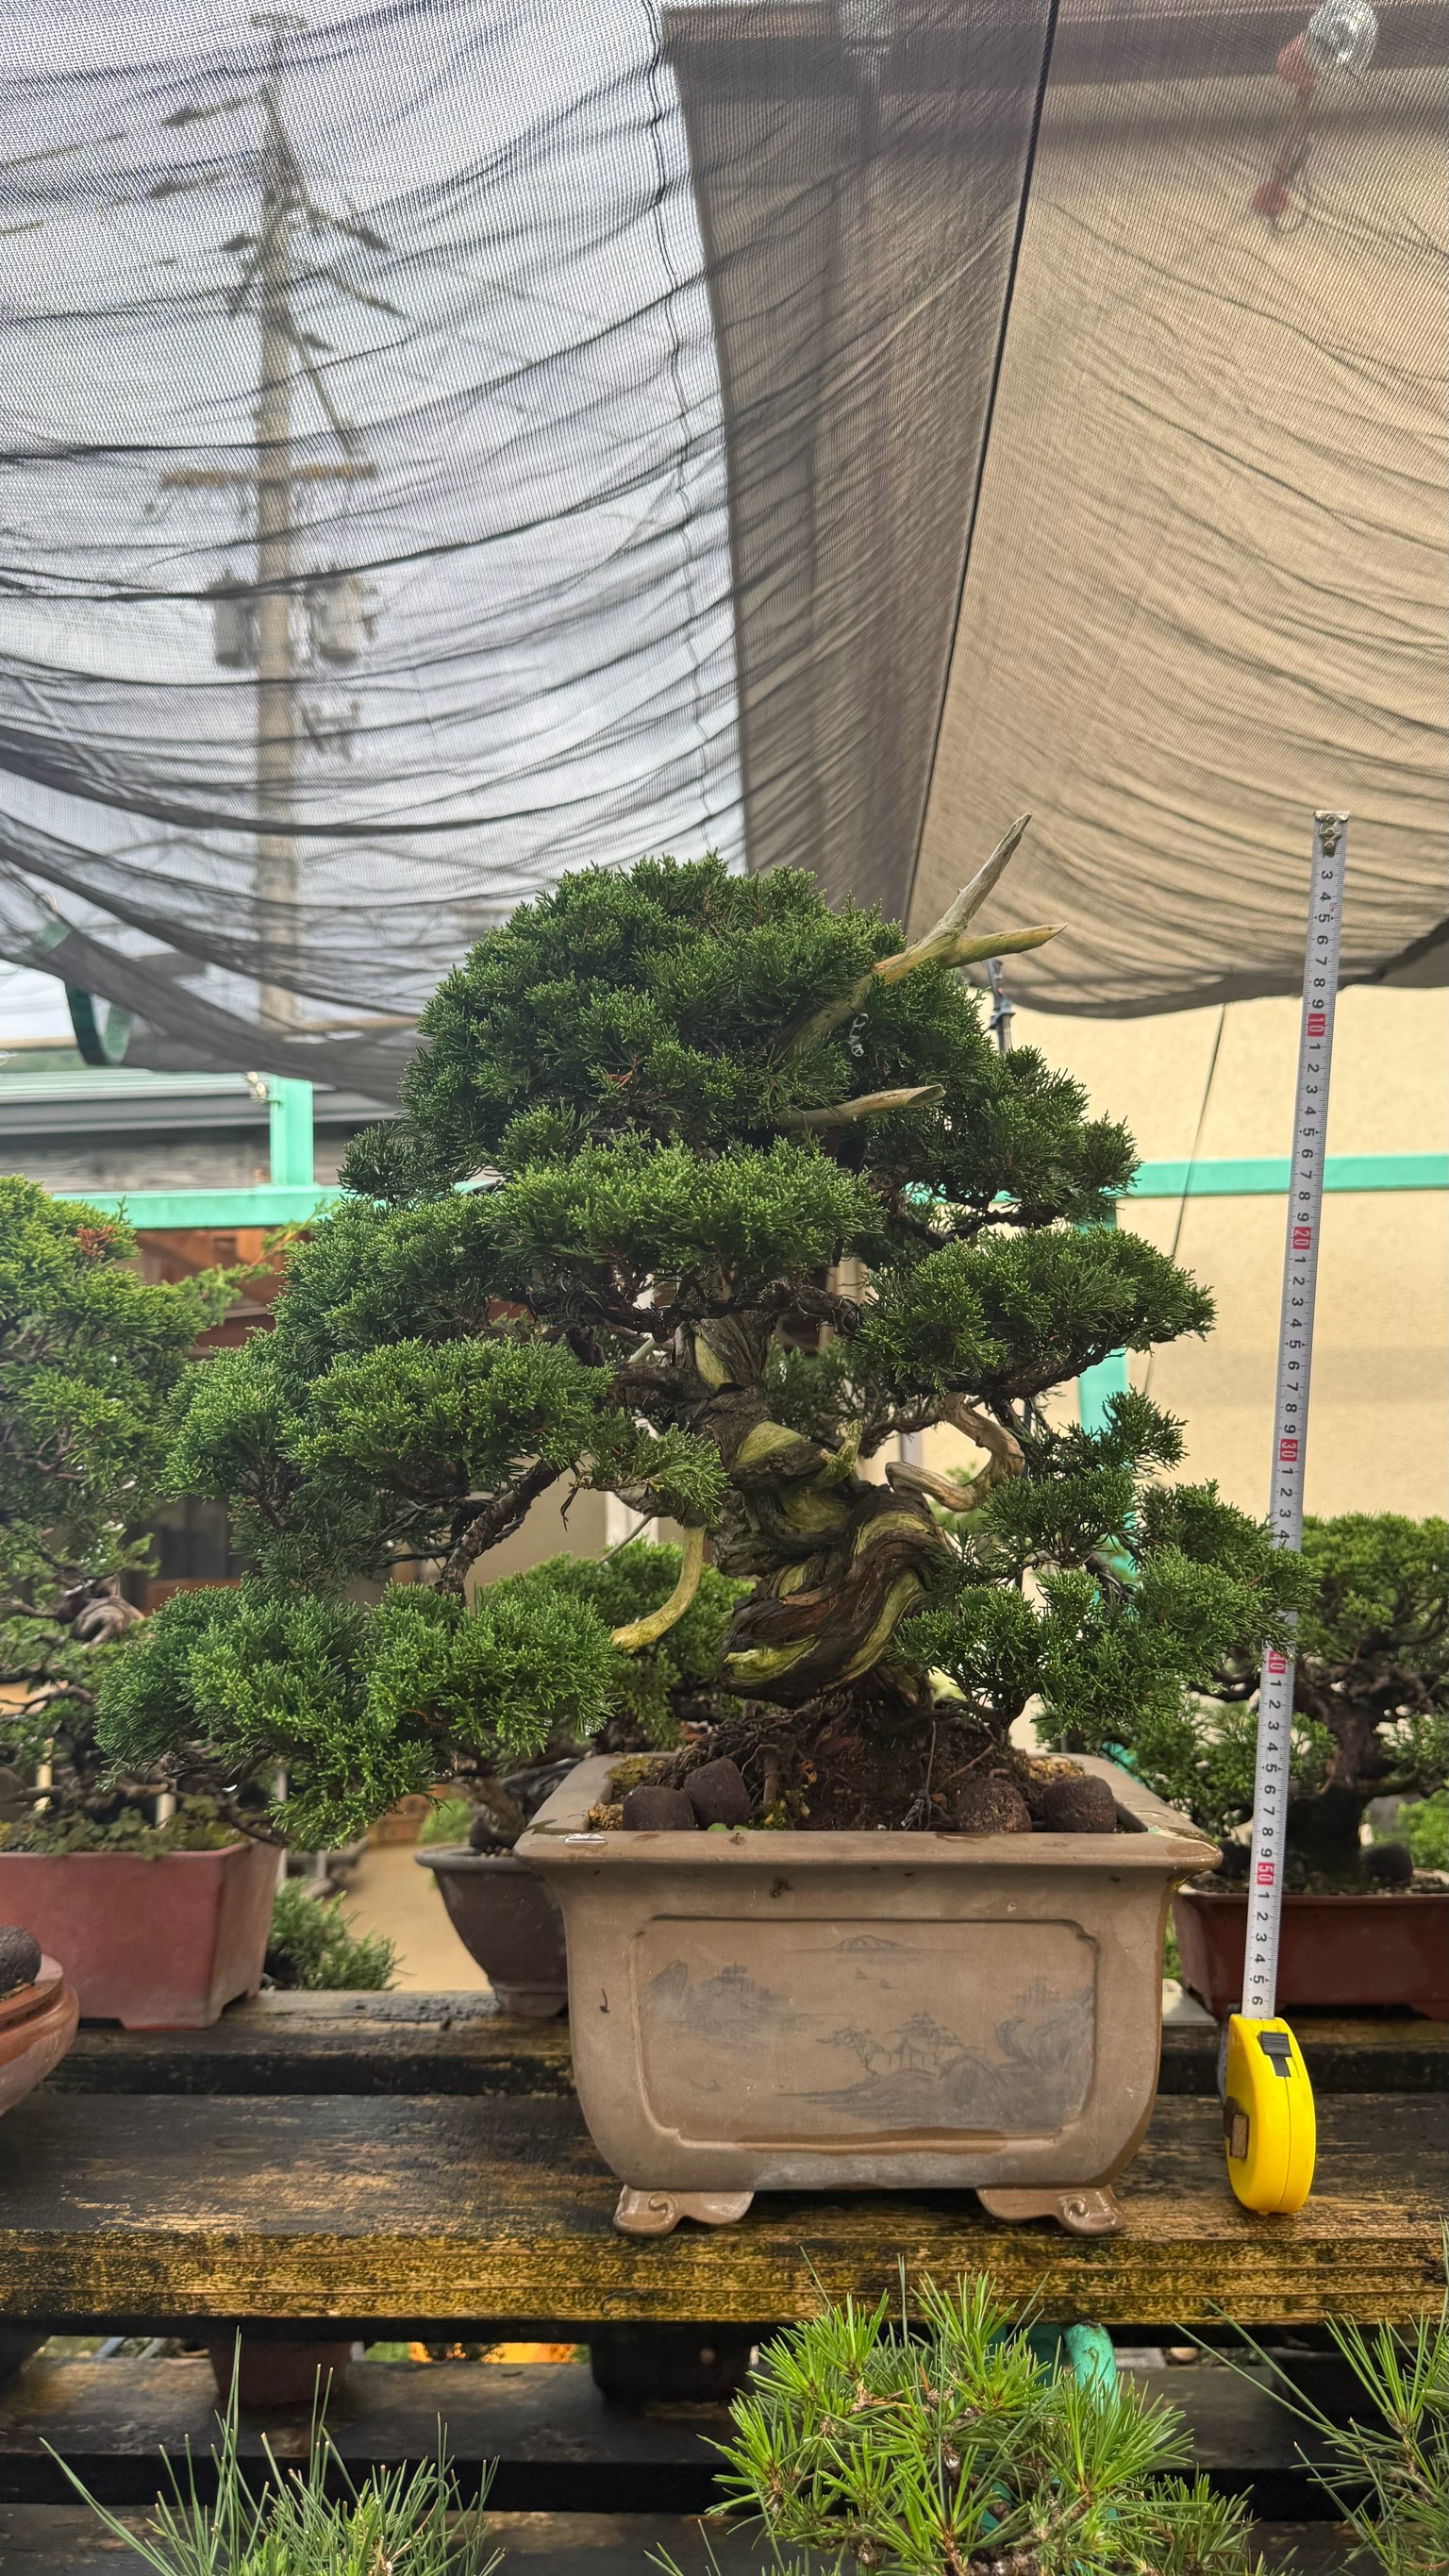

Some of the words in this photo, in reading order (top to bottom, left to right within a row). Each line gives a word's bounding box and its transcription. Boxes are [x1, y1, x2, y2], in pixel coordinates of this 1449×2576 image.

[1321, 870, 1333, 880] 3
[1319, 892, 1331, 902] 4
[1318, 913, 1331, 923] 5
[1316, 935, 1328, 945] 6
[1315, 956, 1327, 966] 7
[1313, 978, 1325, 988] 8
[1312, 999, 1324, 1009] 9
[1308, 1017, 1324, 1032] 10
[1307, 1063, 1320, 1073] 2
[1306, 1084, 1318, 1095] 3
[1304, 1106, 1317, 1116] 4
[1303, 1128, 1315, 1137] 5
[1301, 1148, 1313, 1159] 6
[1300, 1170, 1312, 1179] 7
[1298, 1191, 1310, 1200] 8
[1297, 1213, 1309, 1222] 9
[1293, 1230, 1310, 1246] 20
[1292, 1276, 1306, 1286] 2
[1291, 1296, 1304, 1307] 3
[1290, 1318, 1303, 1329] 4
[1289, 1339, 1301, 1348] 5
[1288, 1361, 1300, 1371] 6
[1287, 1382, 1299, 1392] 7
[1285, 1403, 1297, 1413] 8
[1284, 1424, 1296, 1434] 9
[1281, 1442, 1296, 1458] 30
[1280, 1487, 1293, 1497] 2
[1279, 1509, 1291, 1518] 3
[1277, 1530, 1291, 1540] 4
[1269, 1699, 1281, 1710] 2
[1268, 1721, 1280, 1731] 3
[1266, 1742, 1278, 1752] 4
[1265, 1763, 1277, 1773] 5
[1264, 1784, 1276, 1795] 6
[1263, 1806, 1275, 1815] 7
[1262, 1827, 1274, 1836] 8
[1260, 1848, 1273, 1858] 9
[1257, 1865, 1274, 1882] 50
[1257, 1911, 1269, 1921] 2
[1256, 1932, 1268, 1942] 3
[1254, 1953, 1266, 1964] 4
[1253, 1974, 1265, 1984] 5
[1252, 1996, 1263, 2006] 6
